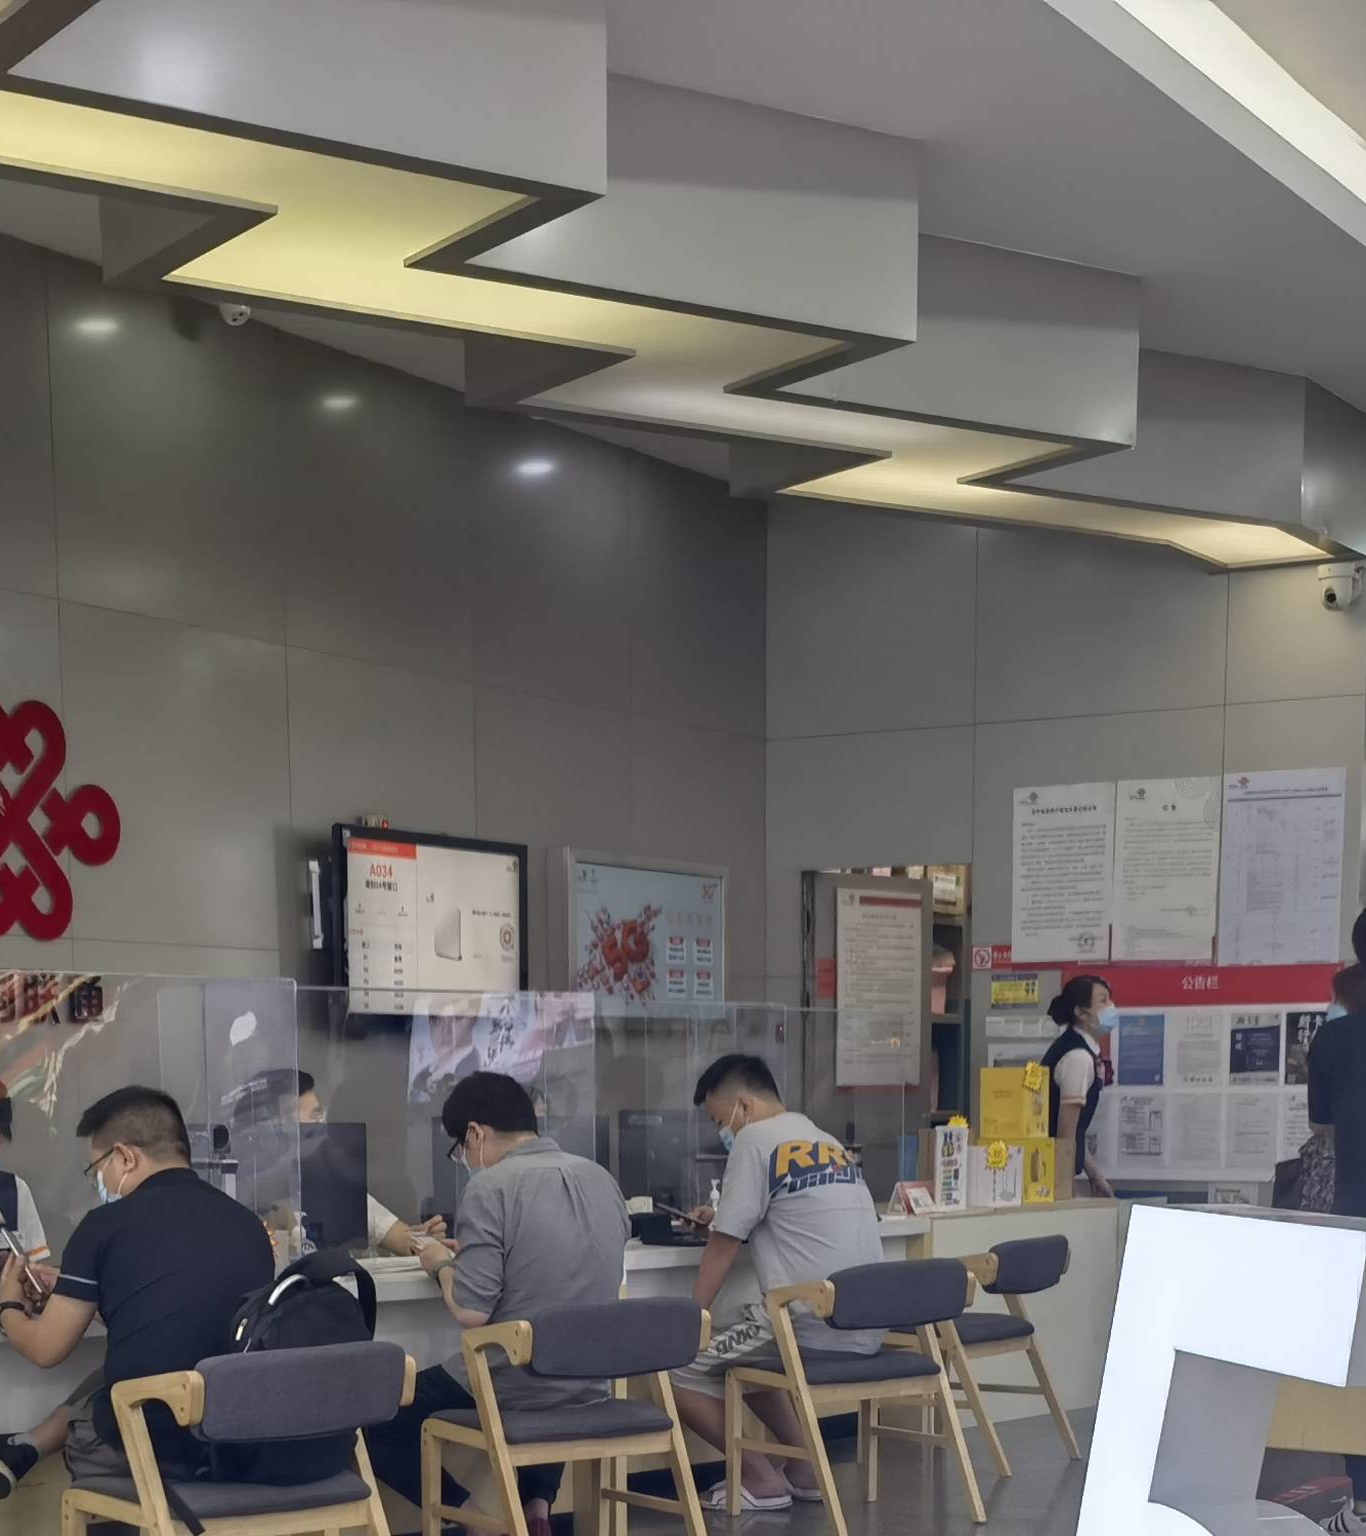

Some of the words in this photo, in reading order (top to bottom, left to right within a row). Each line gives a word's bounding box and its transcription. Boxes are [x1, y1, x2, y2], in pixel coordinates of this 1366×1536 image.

[369, 863, 394, 878] A034
[1181, 974, 1219, 991] 公告栏
